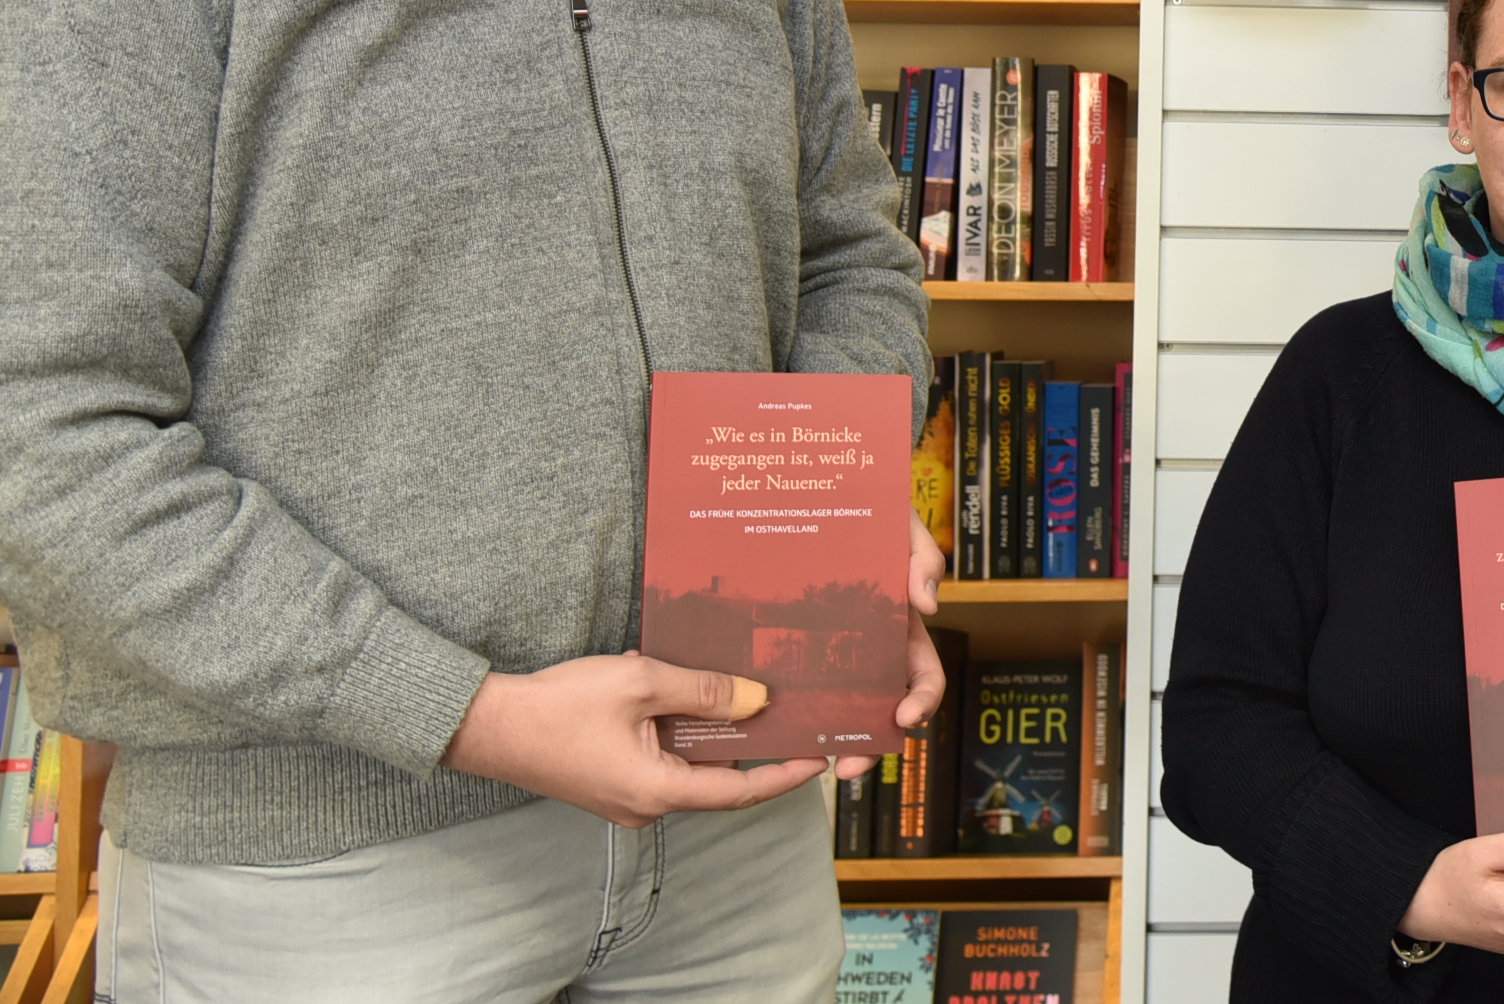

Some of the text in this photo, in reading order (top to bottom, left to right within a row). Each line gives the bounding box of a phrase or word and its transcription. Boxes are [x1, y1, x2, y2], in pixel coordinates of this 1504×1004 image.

[992, 90, 1017, 253] DEON MEYER
[966, 204, 982, 247] IVAR
[706, 427, 861, 444] „Wie es in Börnicke
[691, 449, 874, 469] zugegangen ist, weiß ja
[721, 474, 843, 495] jeder Nauener.“
[690, 508, 872, 518] DAS FRÜHE KONZENTRATIONSLAGER BÖRNICKE
[968, 485, 979, 534] rendell
[756, 525, 818, 533] OSTHAVELLAND
[979, 708, 1067, 744] GIER
[835, 734, 872, 742] METROPOL
[977, 927, 1038, 941] SIMONE
[964, 943, 1050, 958] BUCHHOLZ
